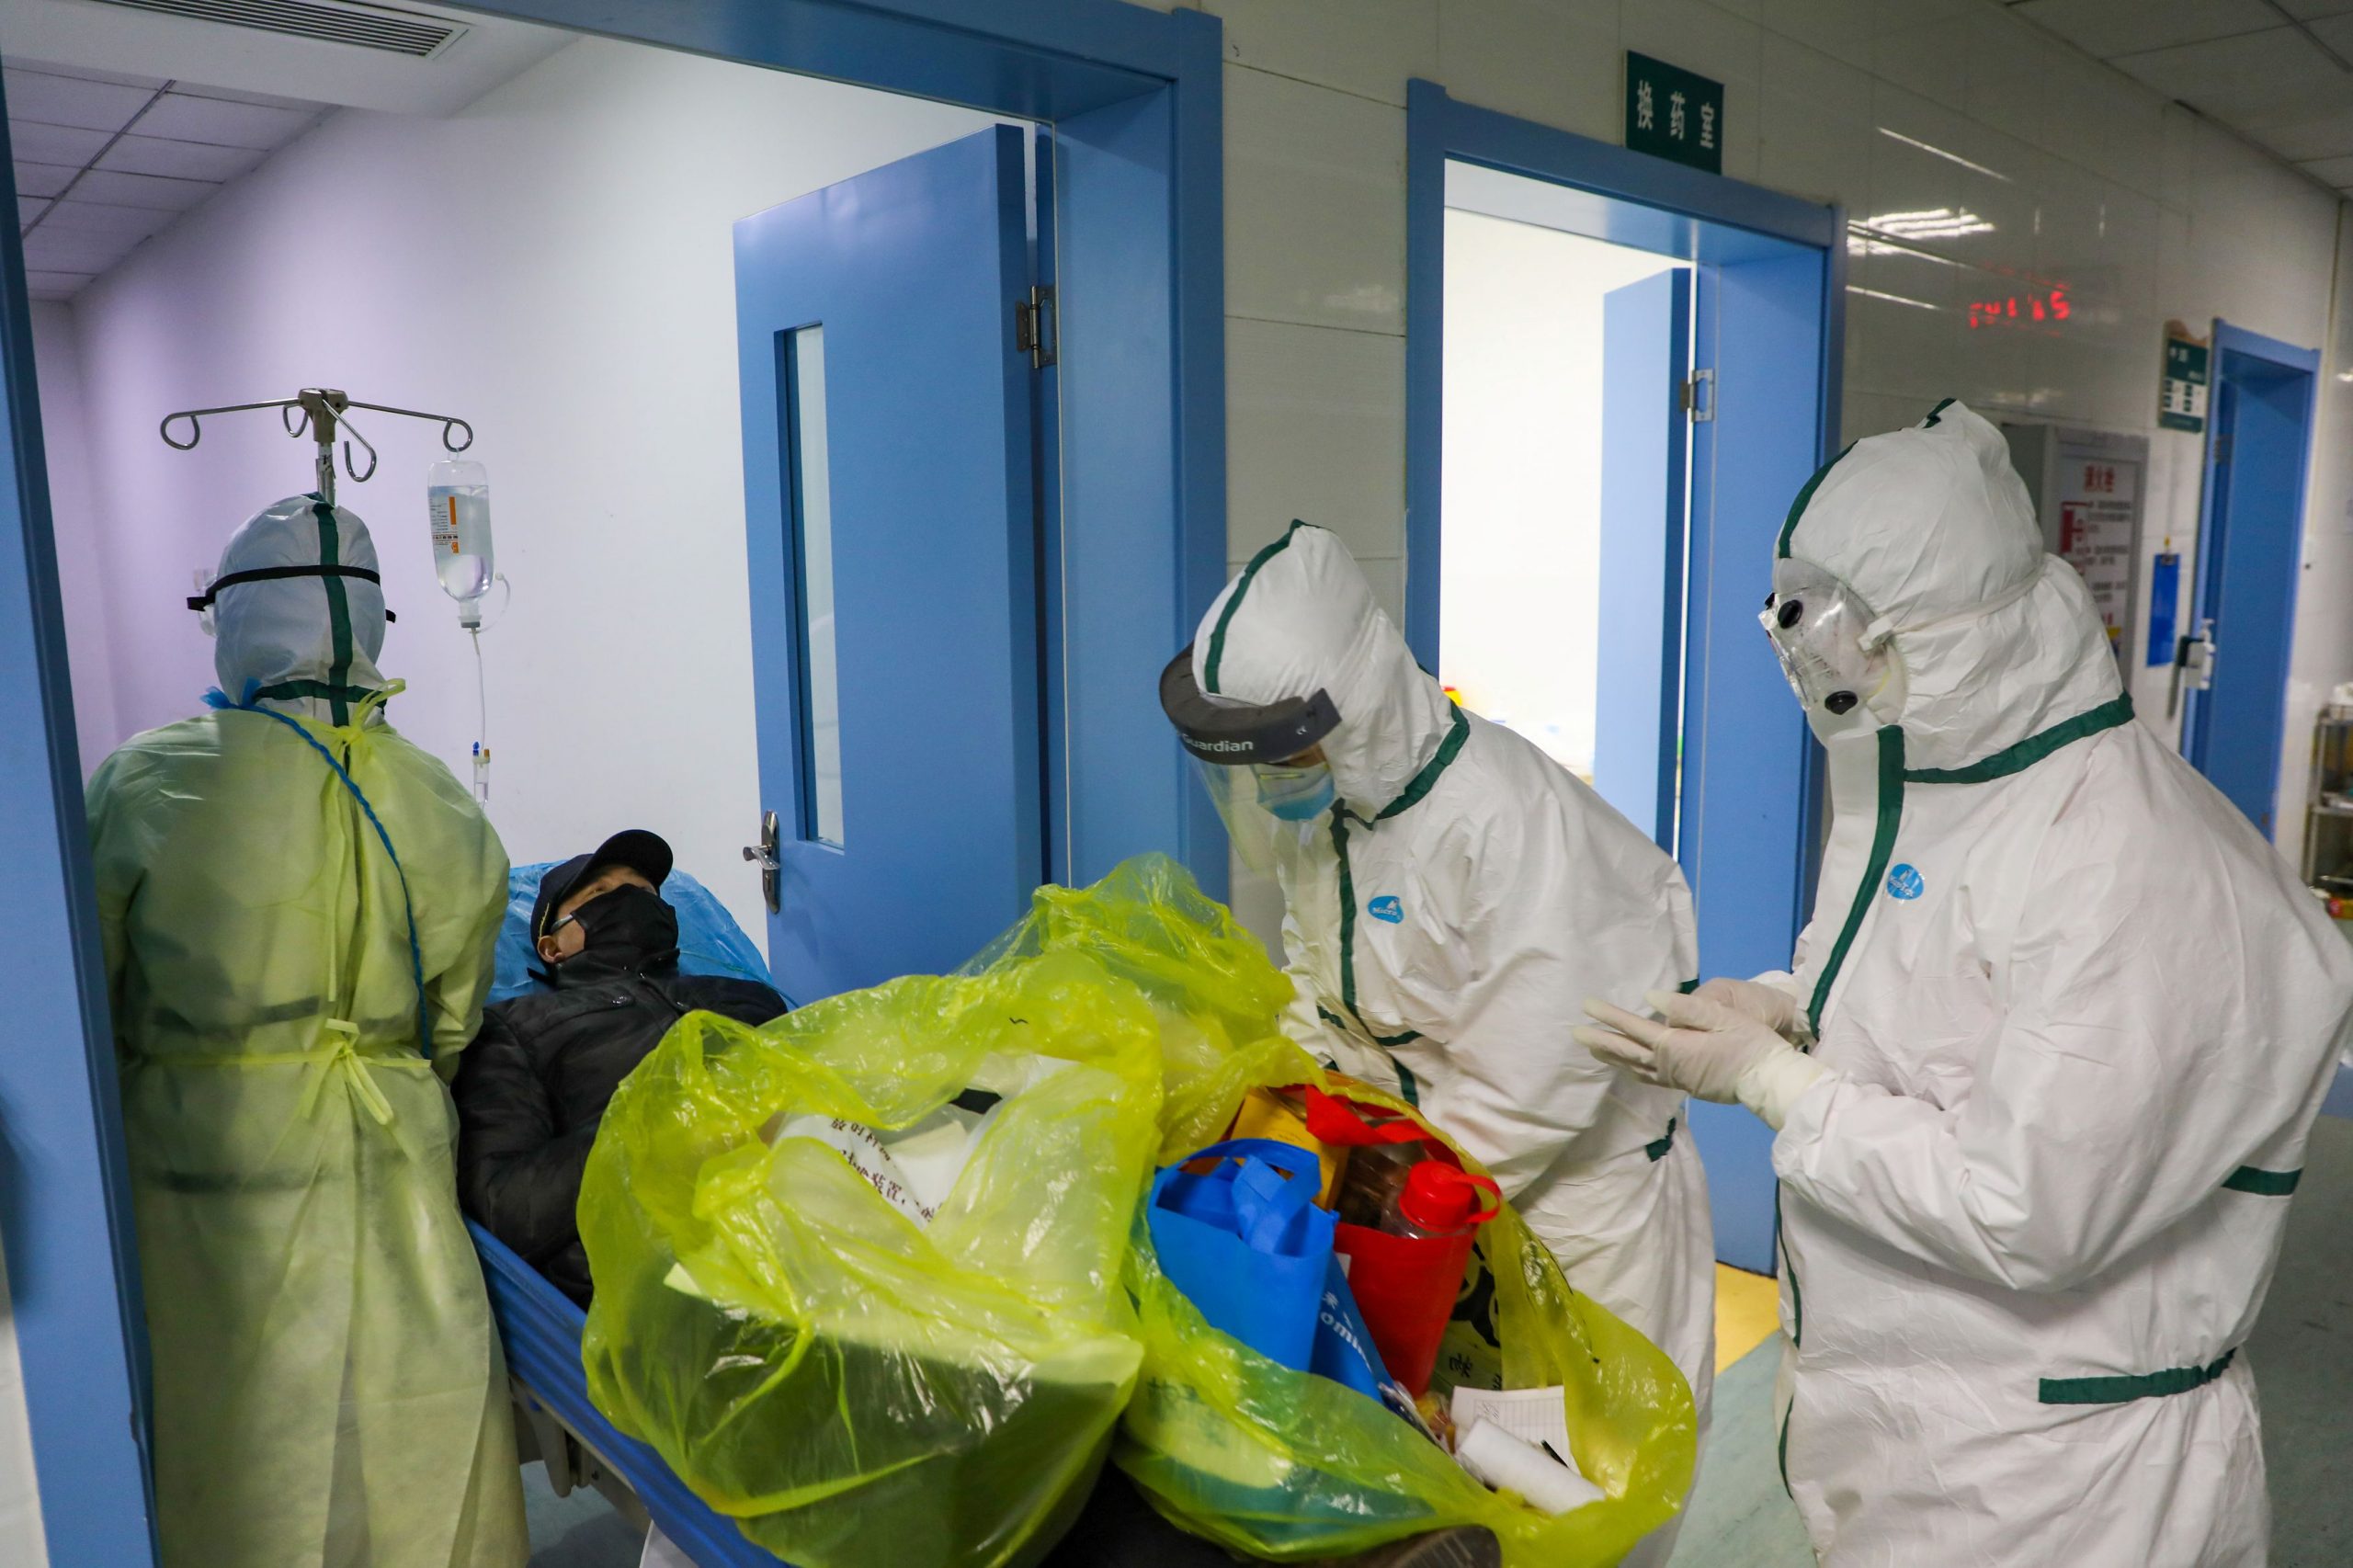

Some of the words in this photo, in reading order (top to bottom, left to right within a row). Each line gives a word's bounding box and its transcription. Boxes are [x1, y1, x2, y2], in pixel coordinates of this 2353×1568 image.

[1636, 79, 1715, 149] 换药室
[1182, 733, 1254, 752] Guardian
